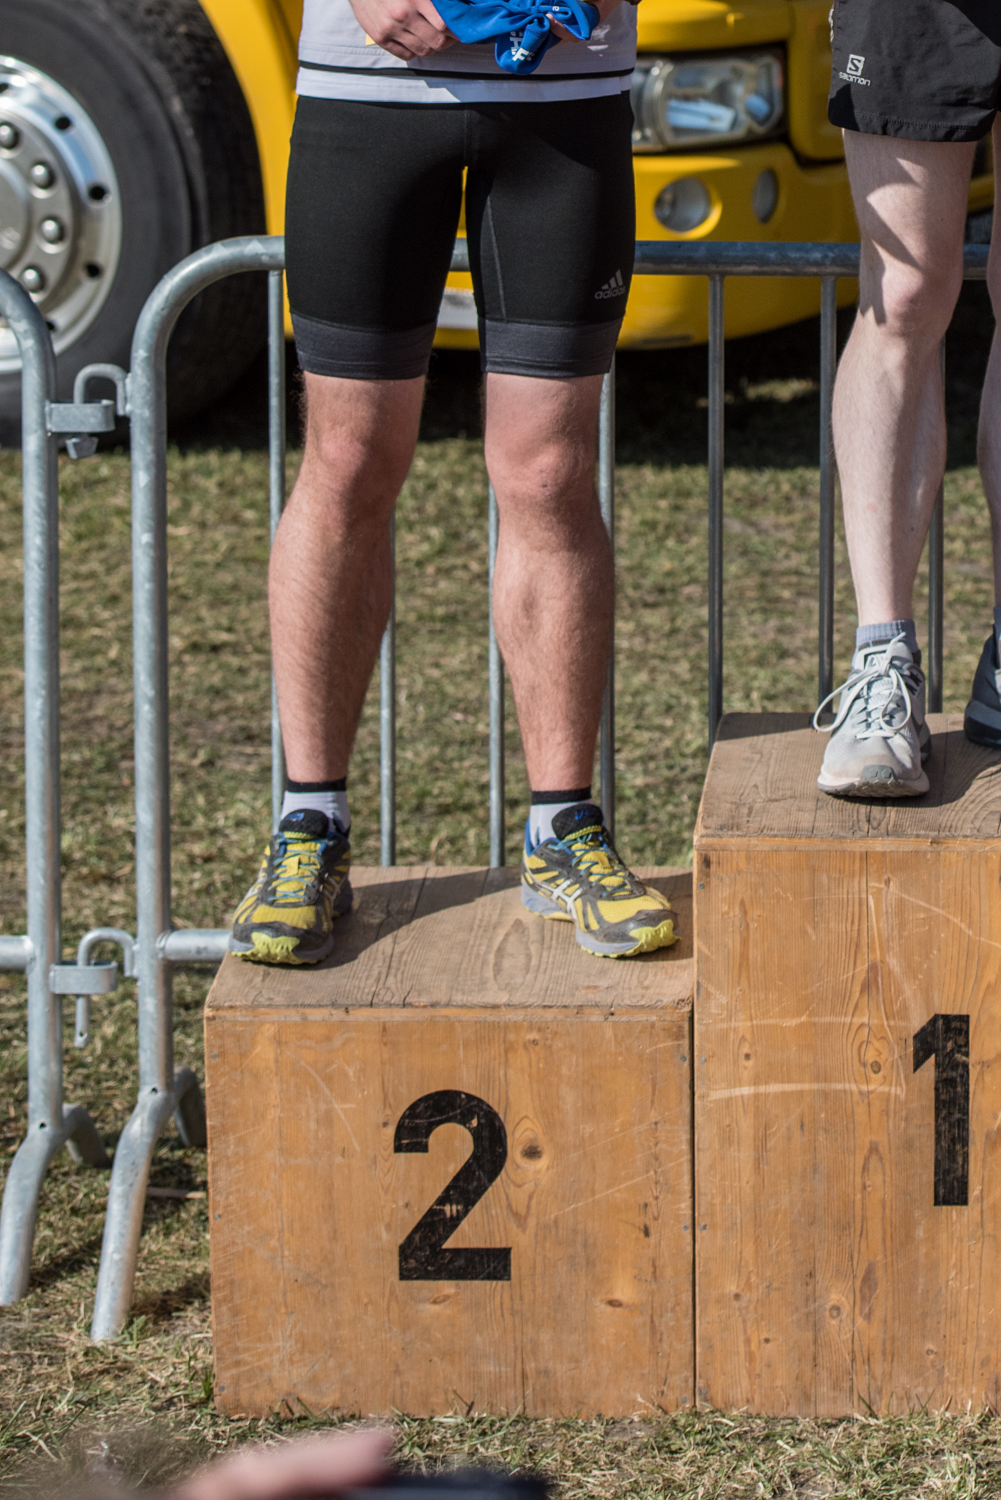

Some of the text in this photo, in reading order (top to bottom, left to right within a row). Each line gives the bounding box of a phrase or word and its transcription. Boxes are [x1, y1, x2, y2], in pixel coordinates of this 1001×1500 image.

[594, 285, 626, 299] adidas
[393, 1089, 512, 1281] 2
[912, 1013, 970, 1206] 1
